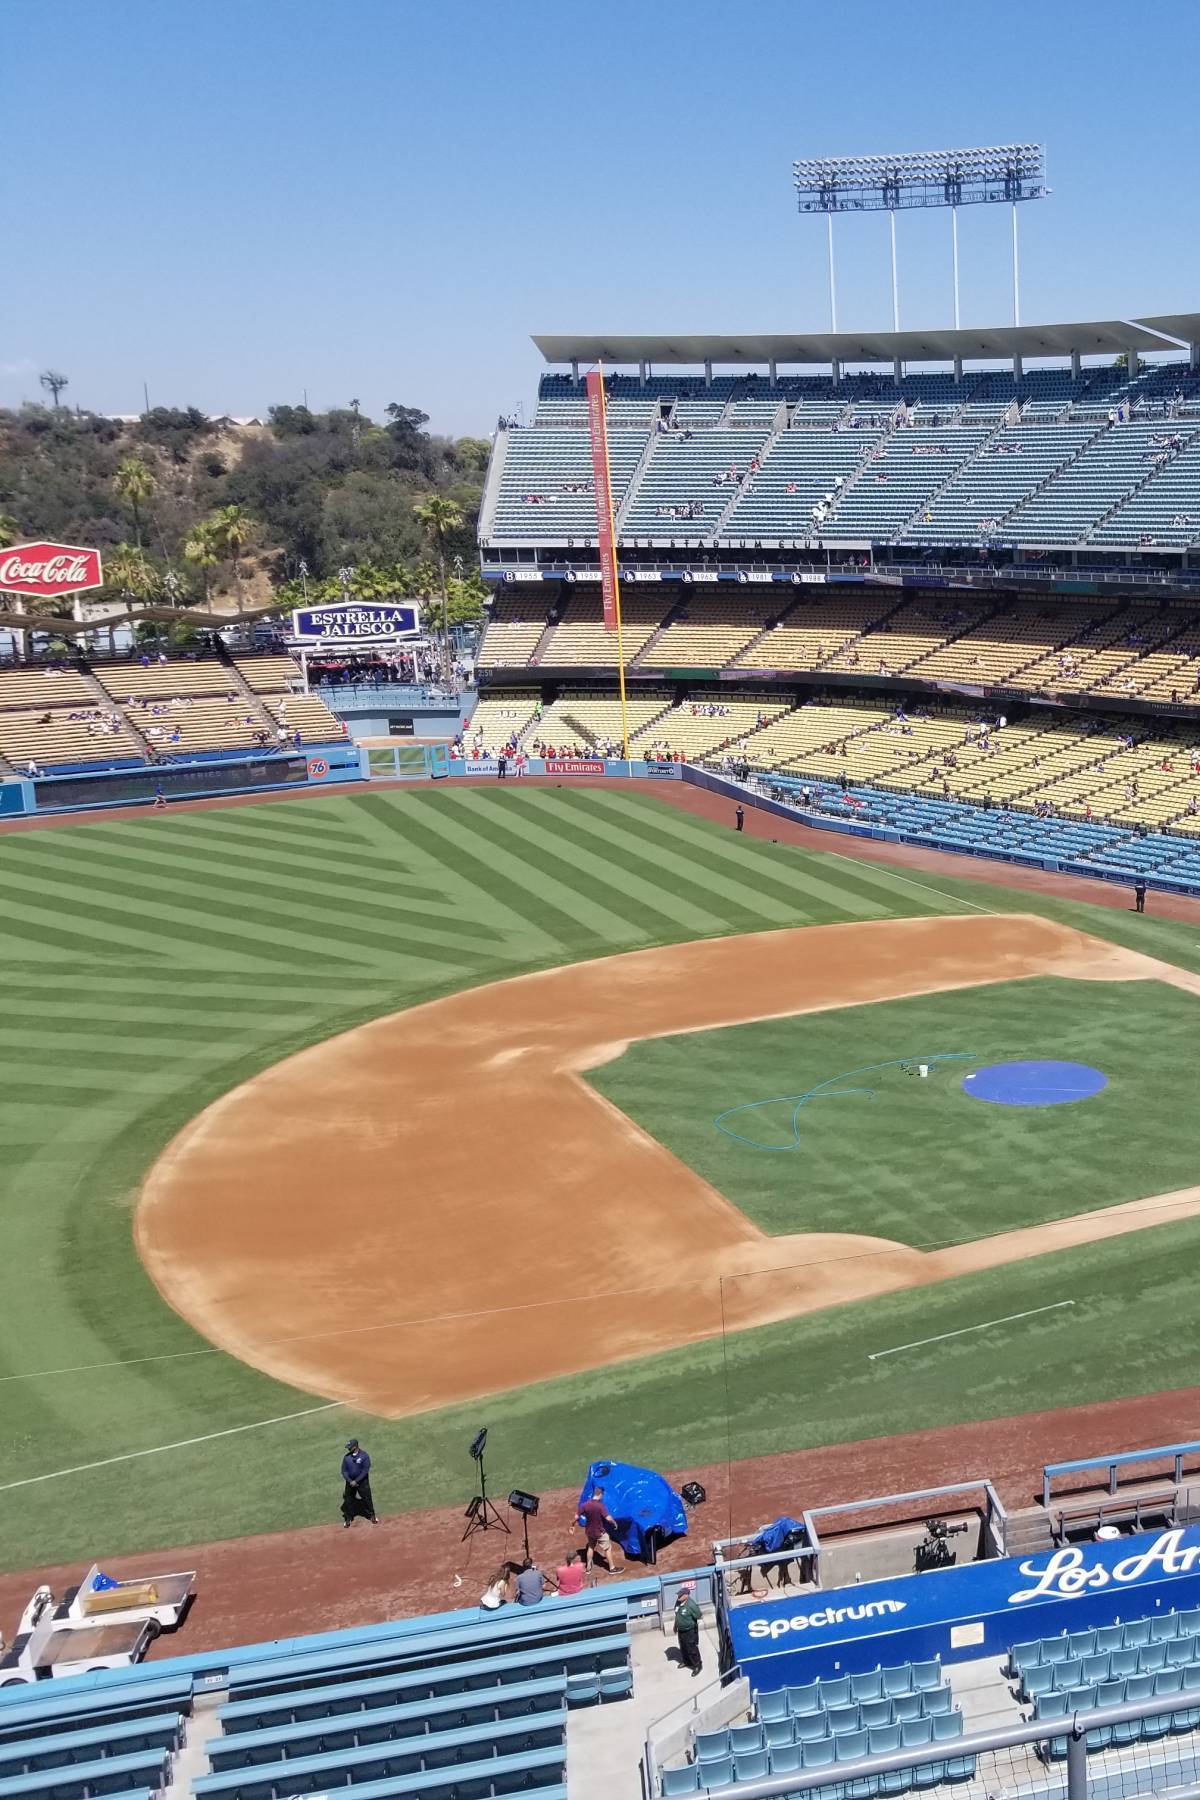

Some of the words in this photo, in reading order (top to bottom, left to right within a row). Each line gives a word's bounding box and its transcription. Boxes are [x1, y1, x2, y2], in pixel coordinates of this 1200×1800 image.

[567, 539, 653, 548] DOGER
[0, 554, 91, 585] Coca-Cola
[519, 572, 538, 580] 1955
[580, 572, 599, 580] 1959
[601, 553, 611, 593] Emirates
[603, 594, 613, 610] Fly
[310, 611, 404, 625] ESTRELLA
[321, 623, 395, 637] JALISCO
[310, 762, 325, 773] 76
[549, 763, 564, 773] Fly
[564, 763, 602, 772] Emirates
[1007, 1547, 1110, 1602] Los
[747, 1600, 899, 1640] Spectrum
